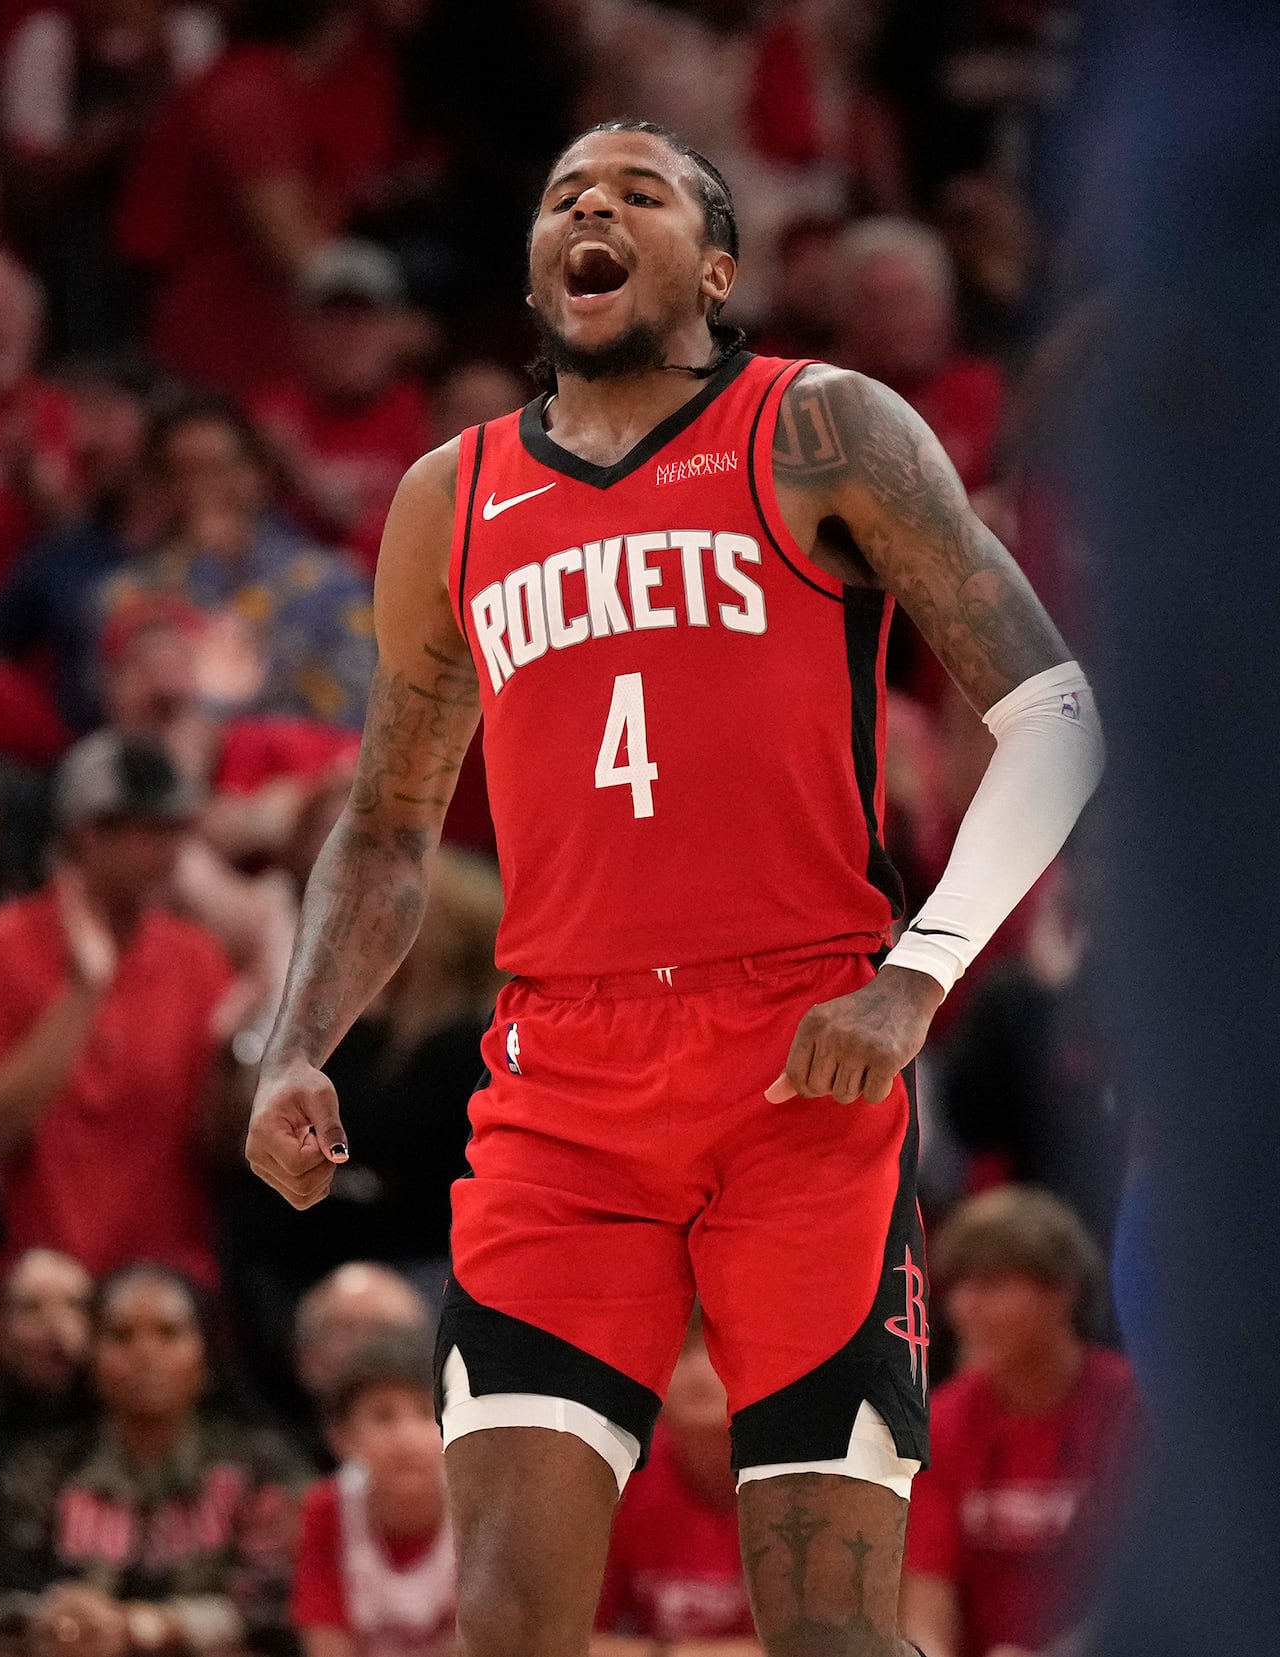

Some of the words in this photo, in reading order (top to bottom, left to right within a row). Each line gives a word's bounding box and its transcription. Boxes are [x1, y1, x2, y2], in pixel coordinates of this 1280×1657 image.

[656, 450, 738, 475] MEMORIAL
[656, 459, 738, 486] HERMANN
[470, 529, 768, 696] ROCKETS
[595, 672, 659, 819] 4
